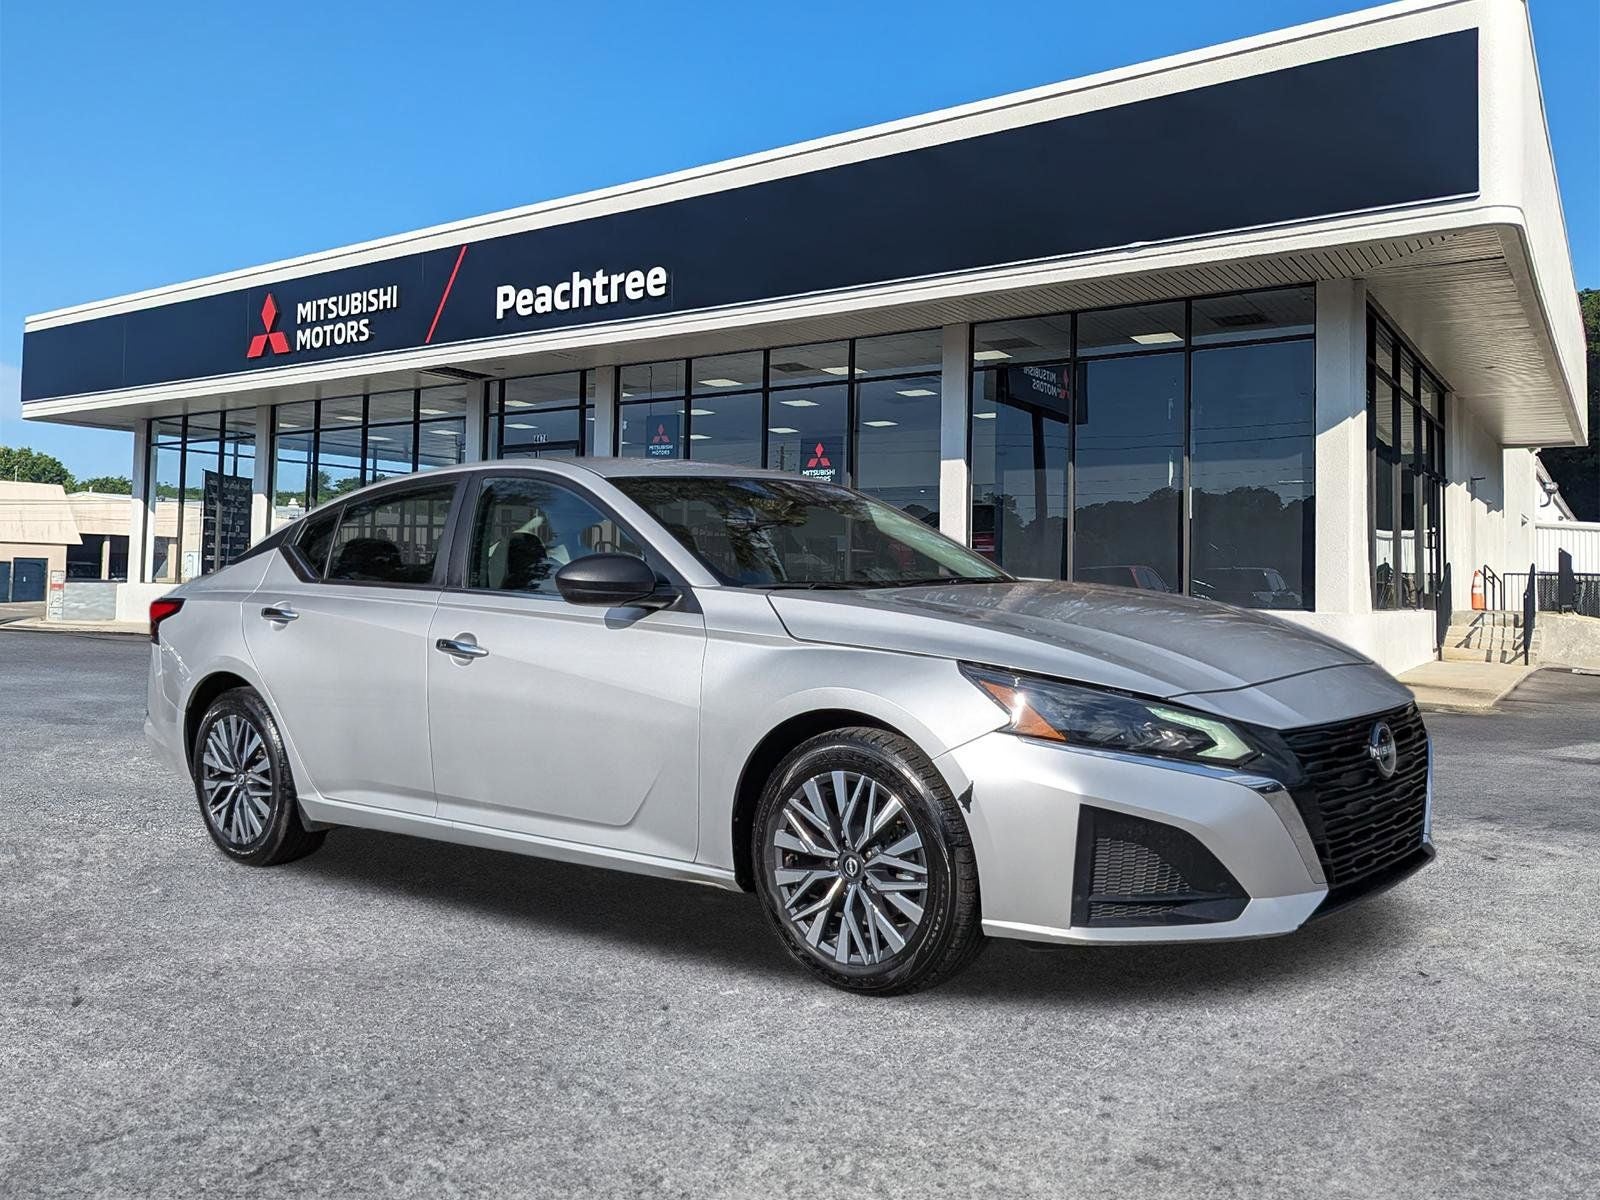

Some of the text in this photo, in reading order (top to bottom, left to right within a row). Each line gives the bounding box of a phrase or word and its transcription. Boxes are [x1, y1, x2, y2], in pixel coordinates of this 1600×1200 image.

[297, 285, 398, 324] MITSUBISHI
[496, 266, 667, 319] Peachtree
[296, 319, 369, 351] MOTORS
